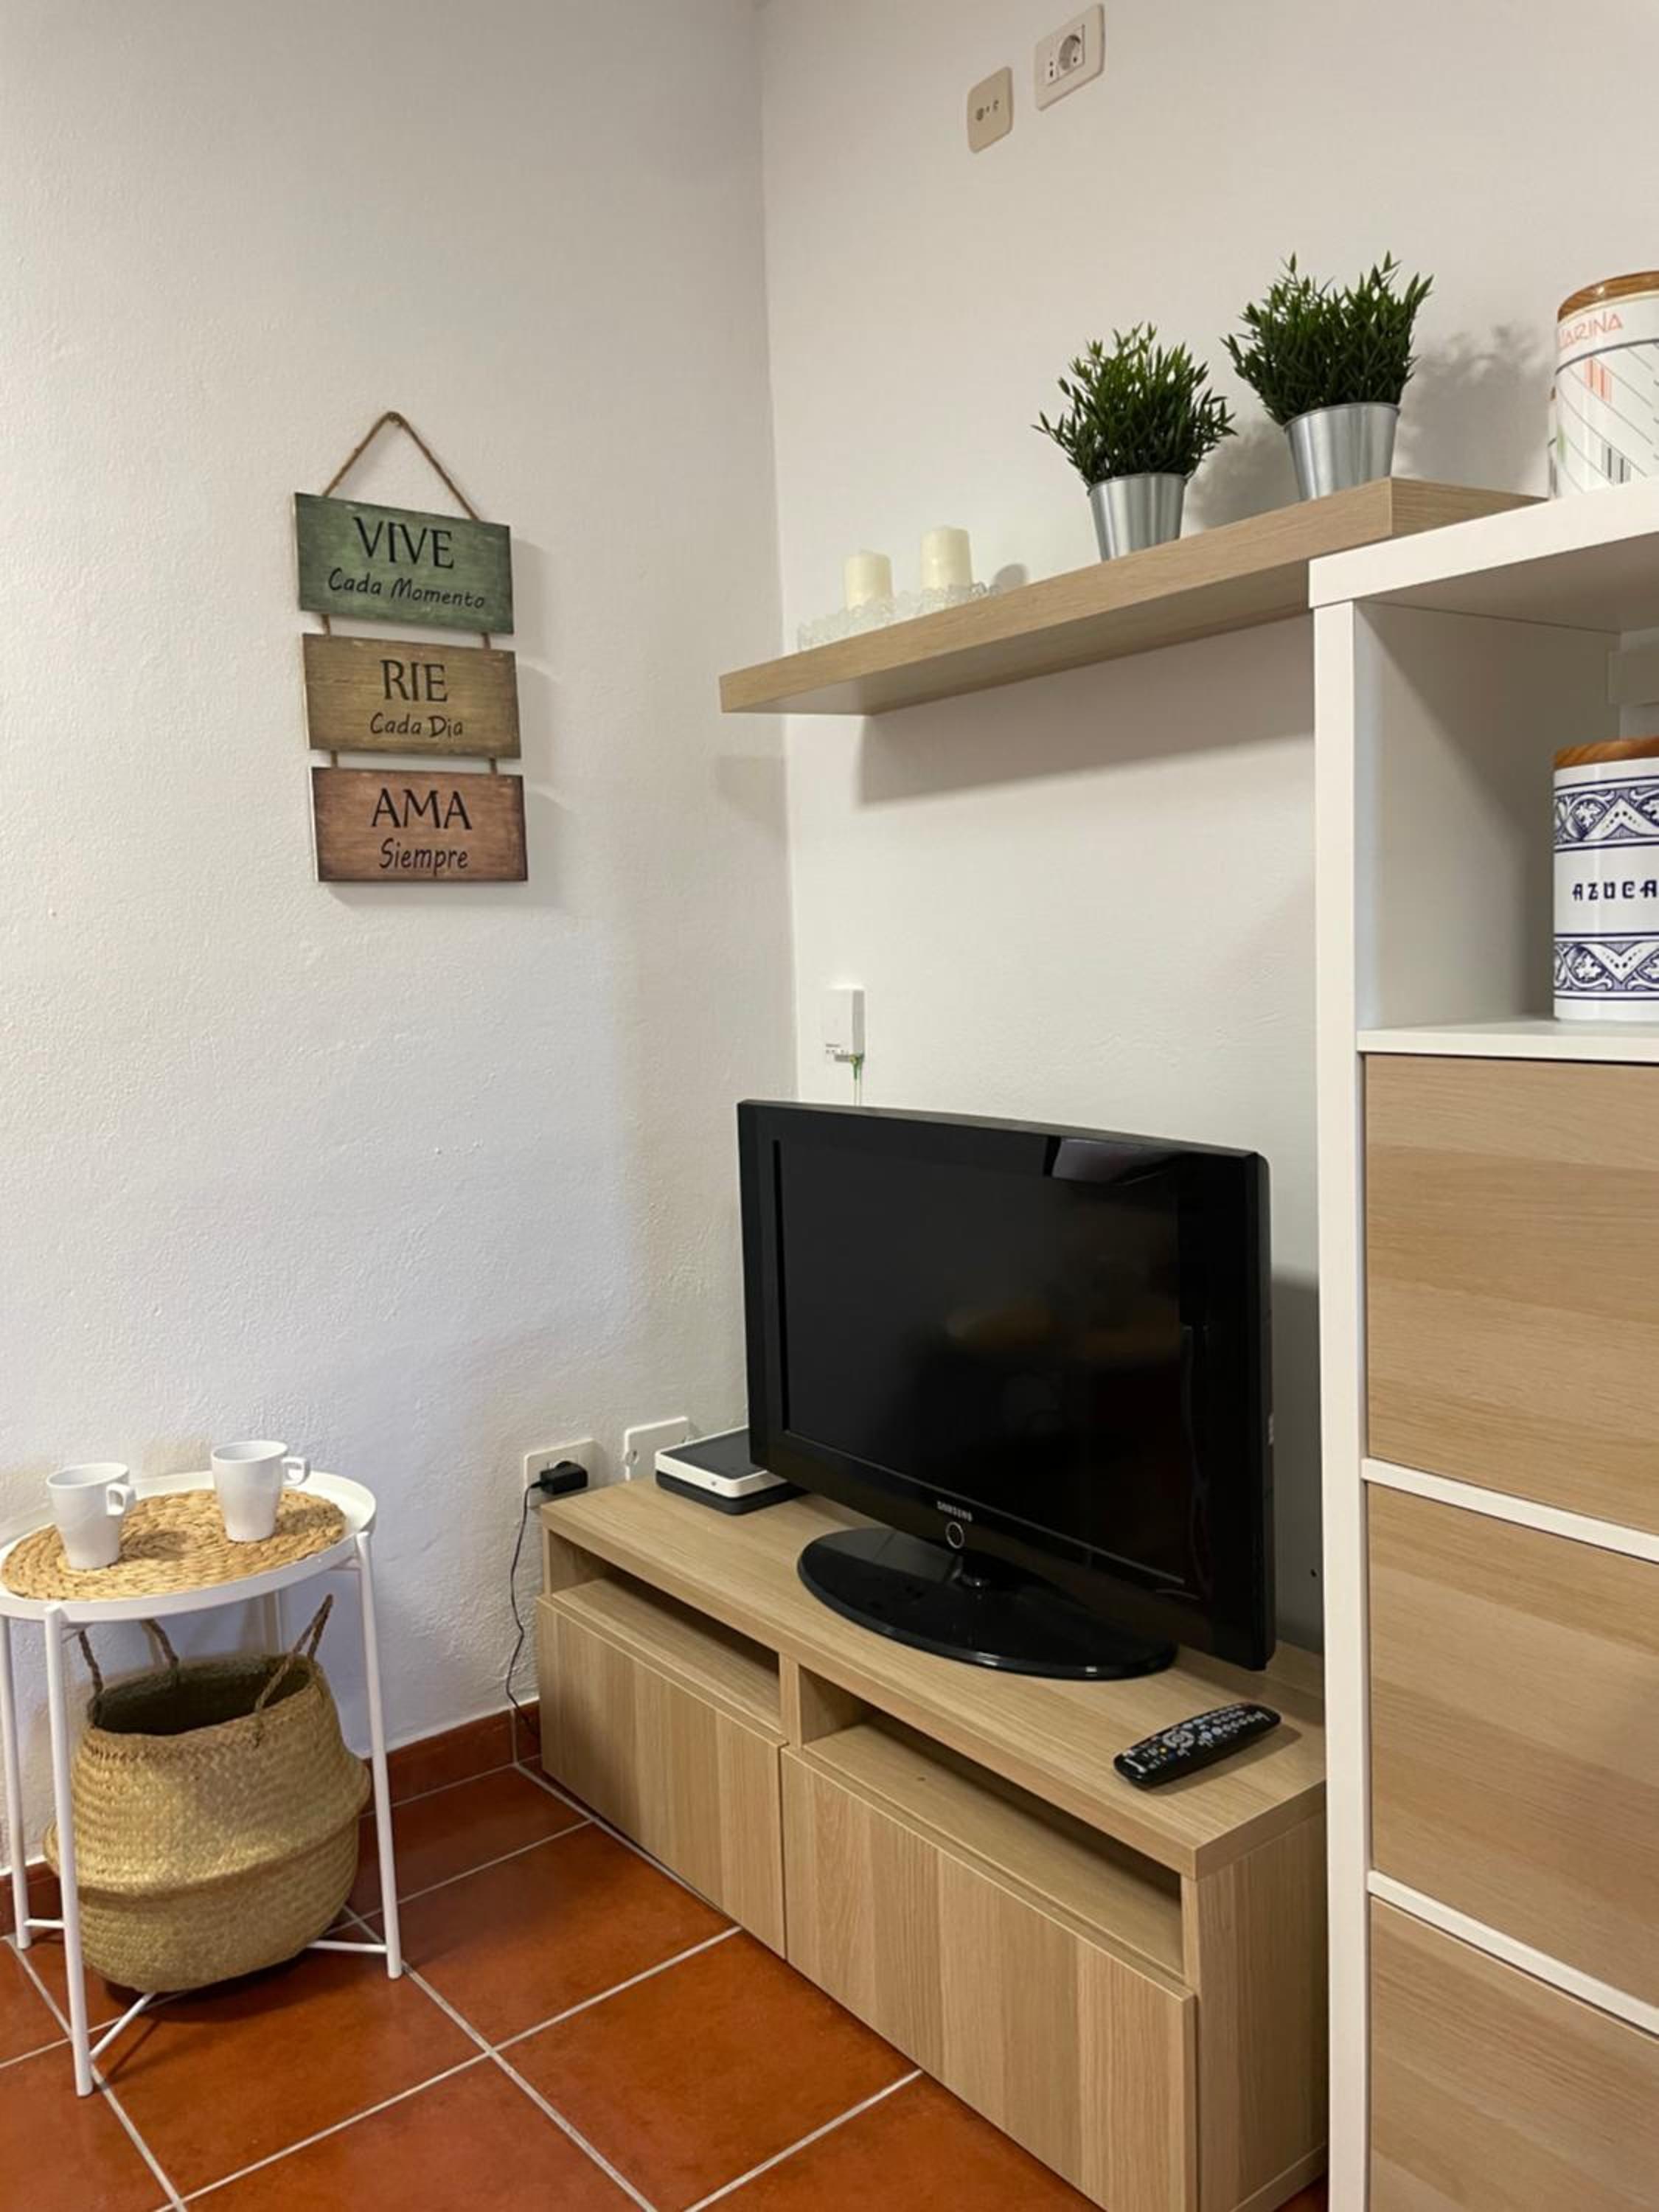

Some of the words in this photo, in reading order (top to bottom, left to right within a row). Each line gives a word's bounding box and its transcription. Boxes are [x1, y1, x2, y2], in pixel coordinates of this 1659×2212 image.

[1557, 311, 1624, 347] ARINA
[353, 517, 454, 568] VIVE
[329, 568, 381, 594] Cada
[391, 578, 485, 608] Momento
[380, 659, 447, 701] RIE
[371, 712, 421, 735] Cada
[428, 716, 463, 737] Dia
[371, 788, 472, 830] AMA
[380, 838, 467, 877] Siempre
